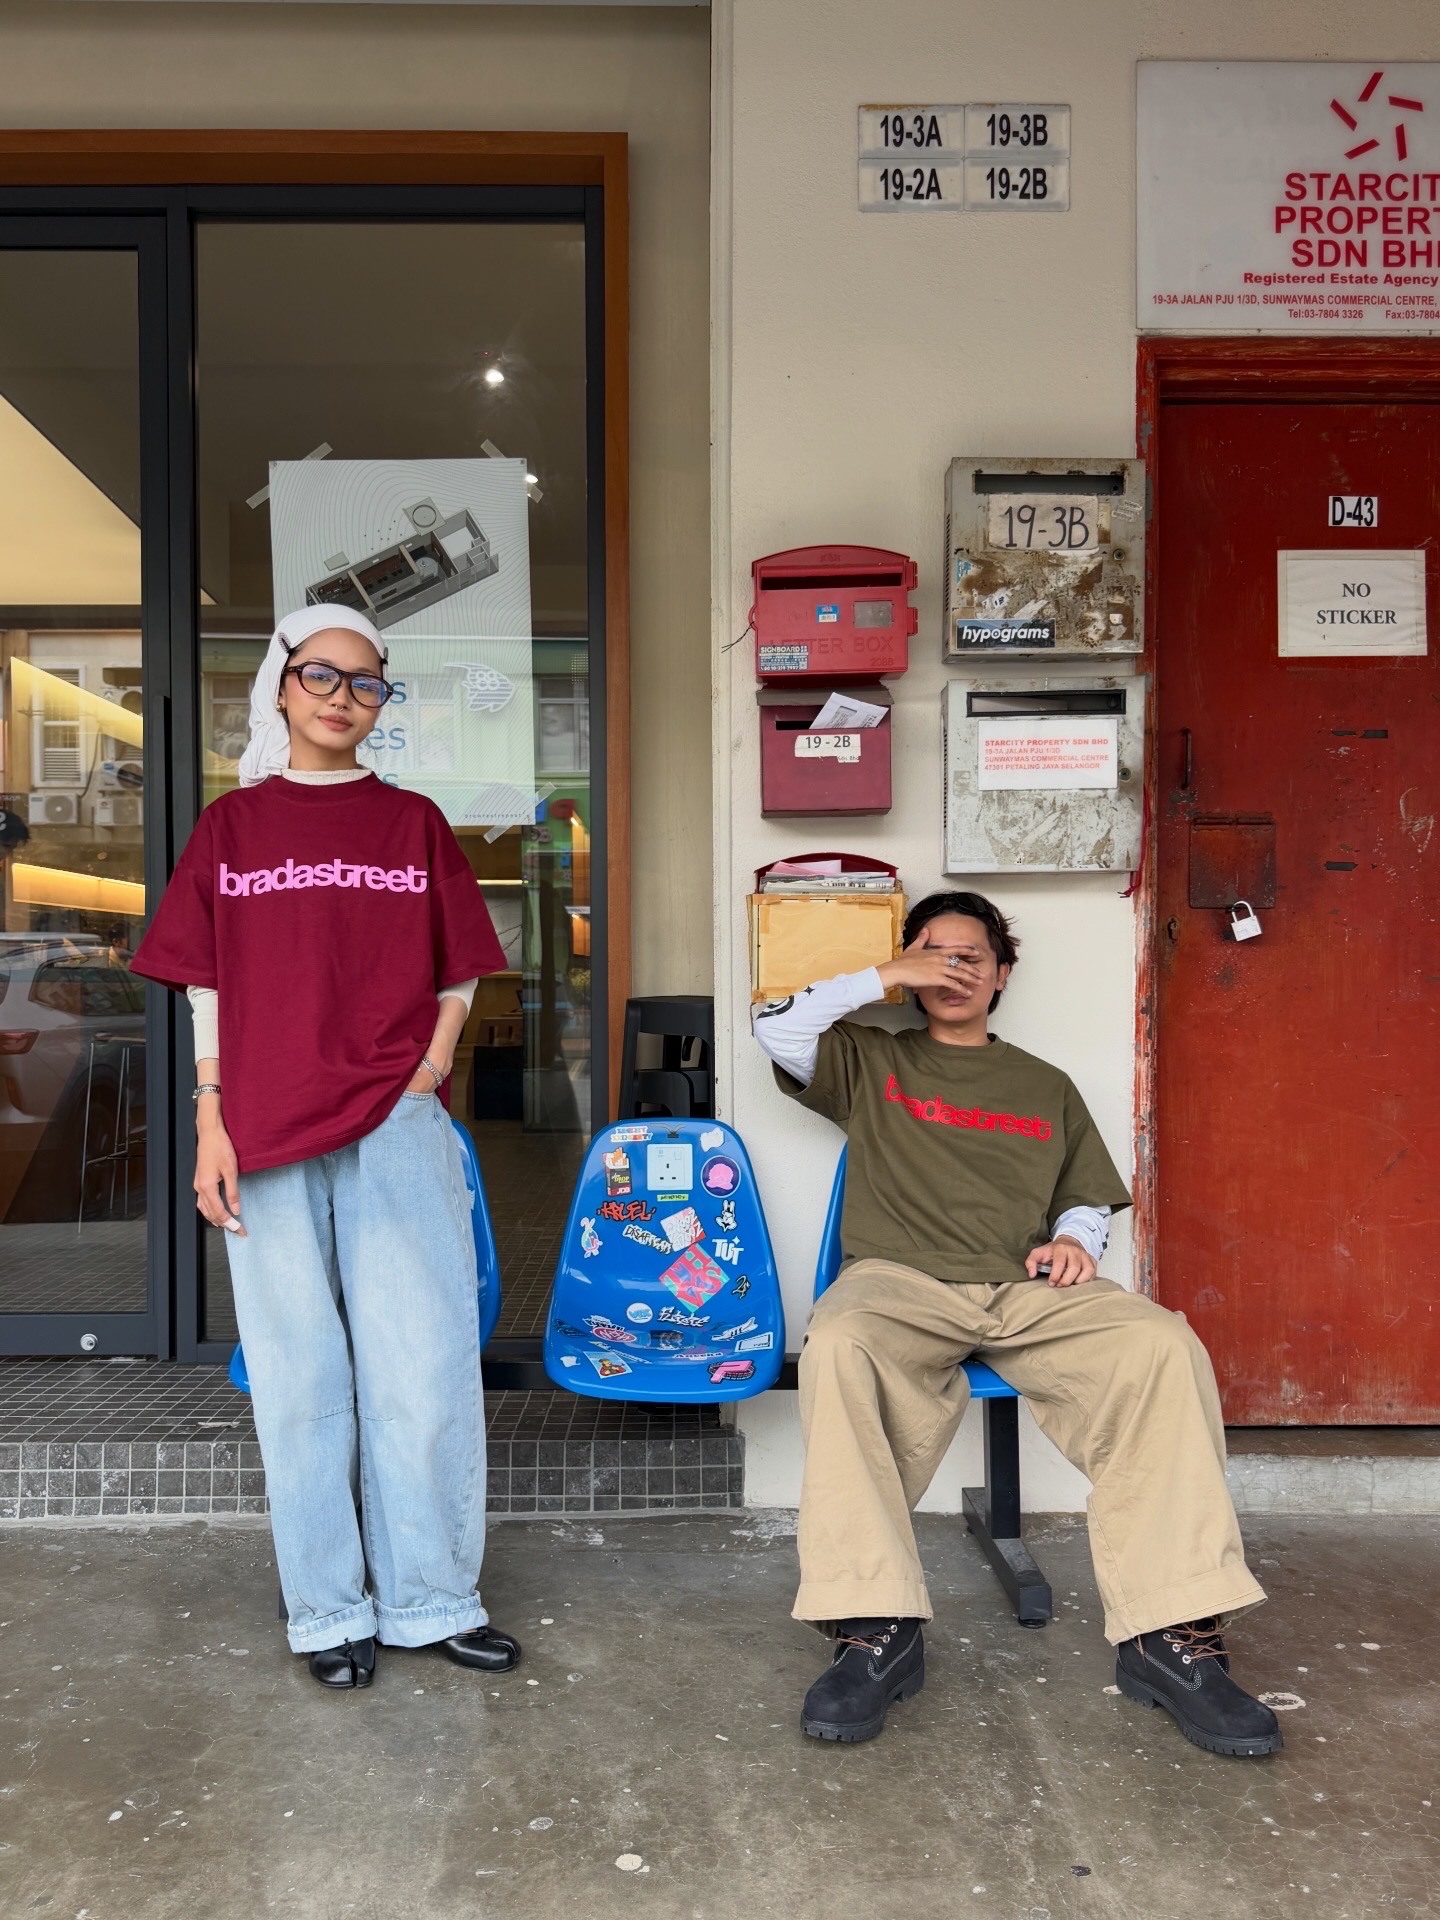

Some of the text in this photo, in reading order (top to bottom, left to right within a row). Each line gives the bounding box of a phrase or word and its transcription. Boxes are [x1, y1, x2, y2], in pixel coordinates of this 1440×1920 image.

[880, 113, 1049, 147] 19-3A 19-3B
[879, 167, 1048, 200] 19-2A 19-2B
[1291, 239, 1440, 268] SDN BH
[1243, 272, 1439, 287] Registered Estate Agency
[1152, 294, 1438, 307] 19-3A JALAN PJU 1/3D, SUNWAYMAS COMMERCIAL, CENTRE,
[1288, 308, 1340, 319] Tel:03-7804
[1342, 309, 1364, 319] 3326
[1332, 496, 1374, 527] D-43
[1004, 504, 1090, 548] 19-3B
[1341, 582, 1371, 598] NO
[1316, 609, 1398, 625] STICKER
[962, 626, 1050, 643] hypograms
[805, 736, 822, 748] 19
[833, 735, 851, 748] 2B
[984, 739, 1025, 747] STARCITY
[219, 858, 428, 897] bradastreet
